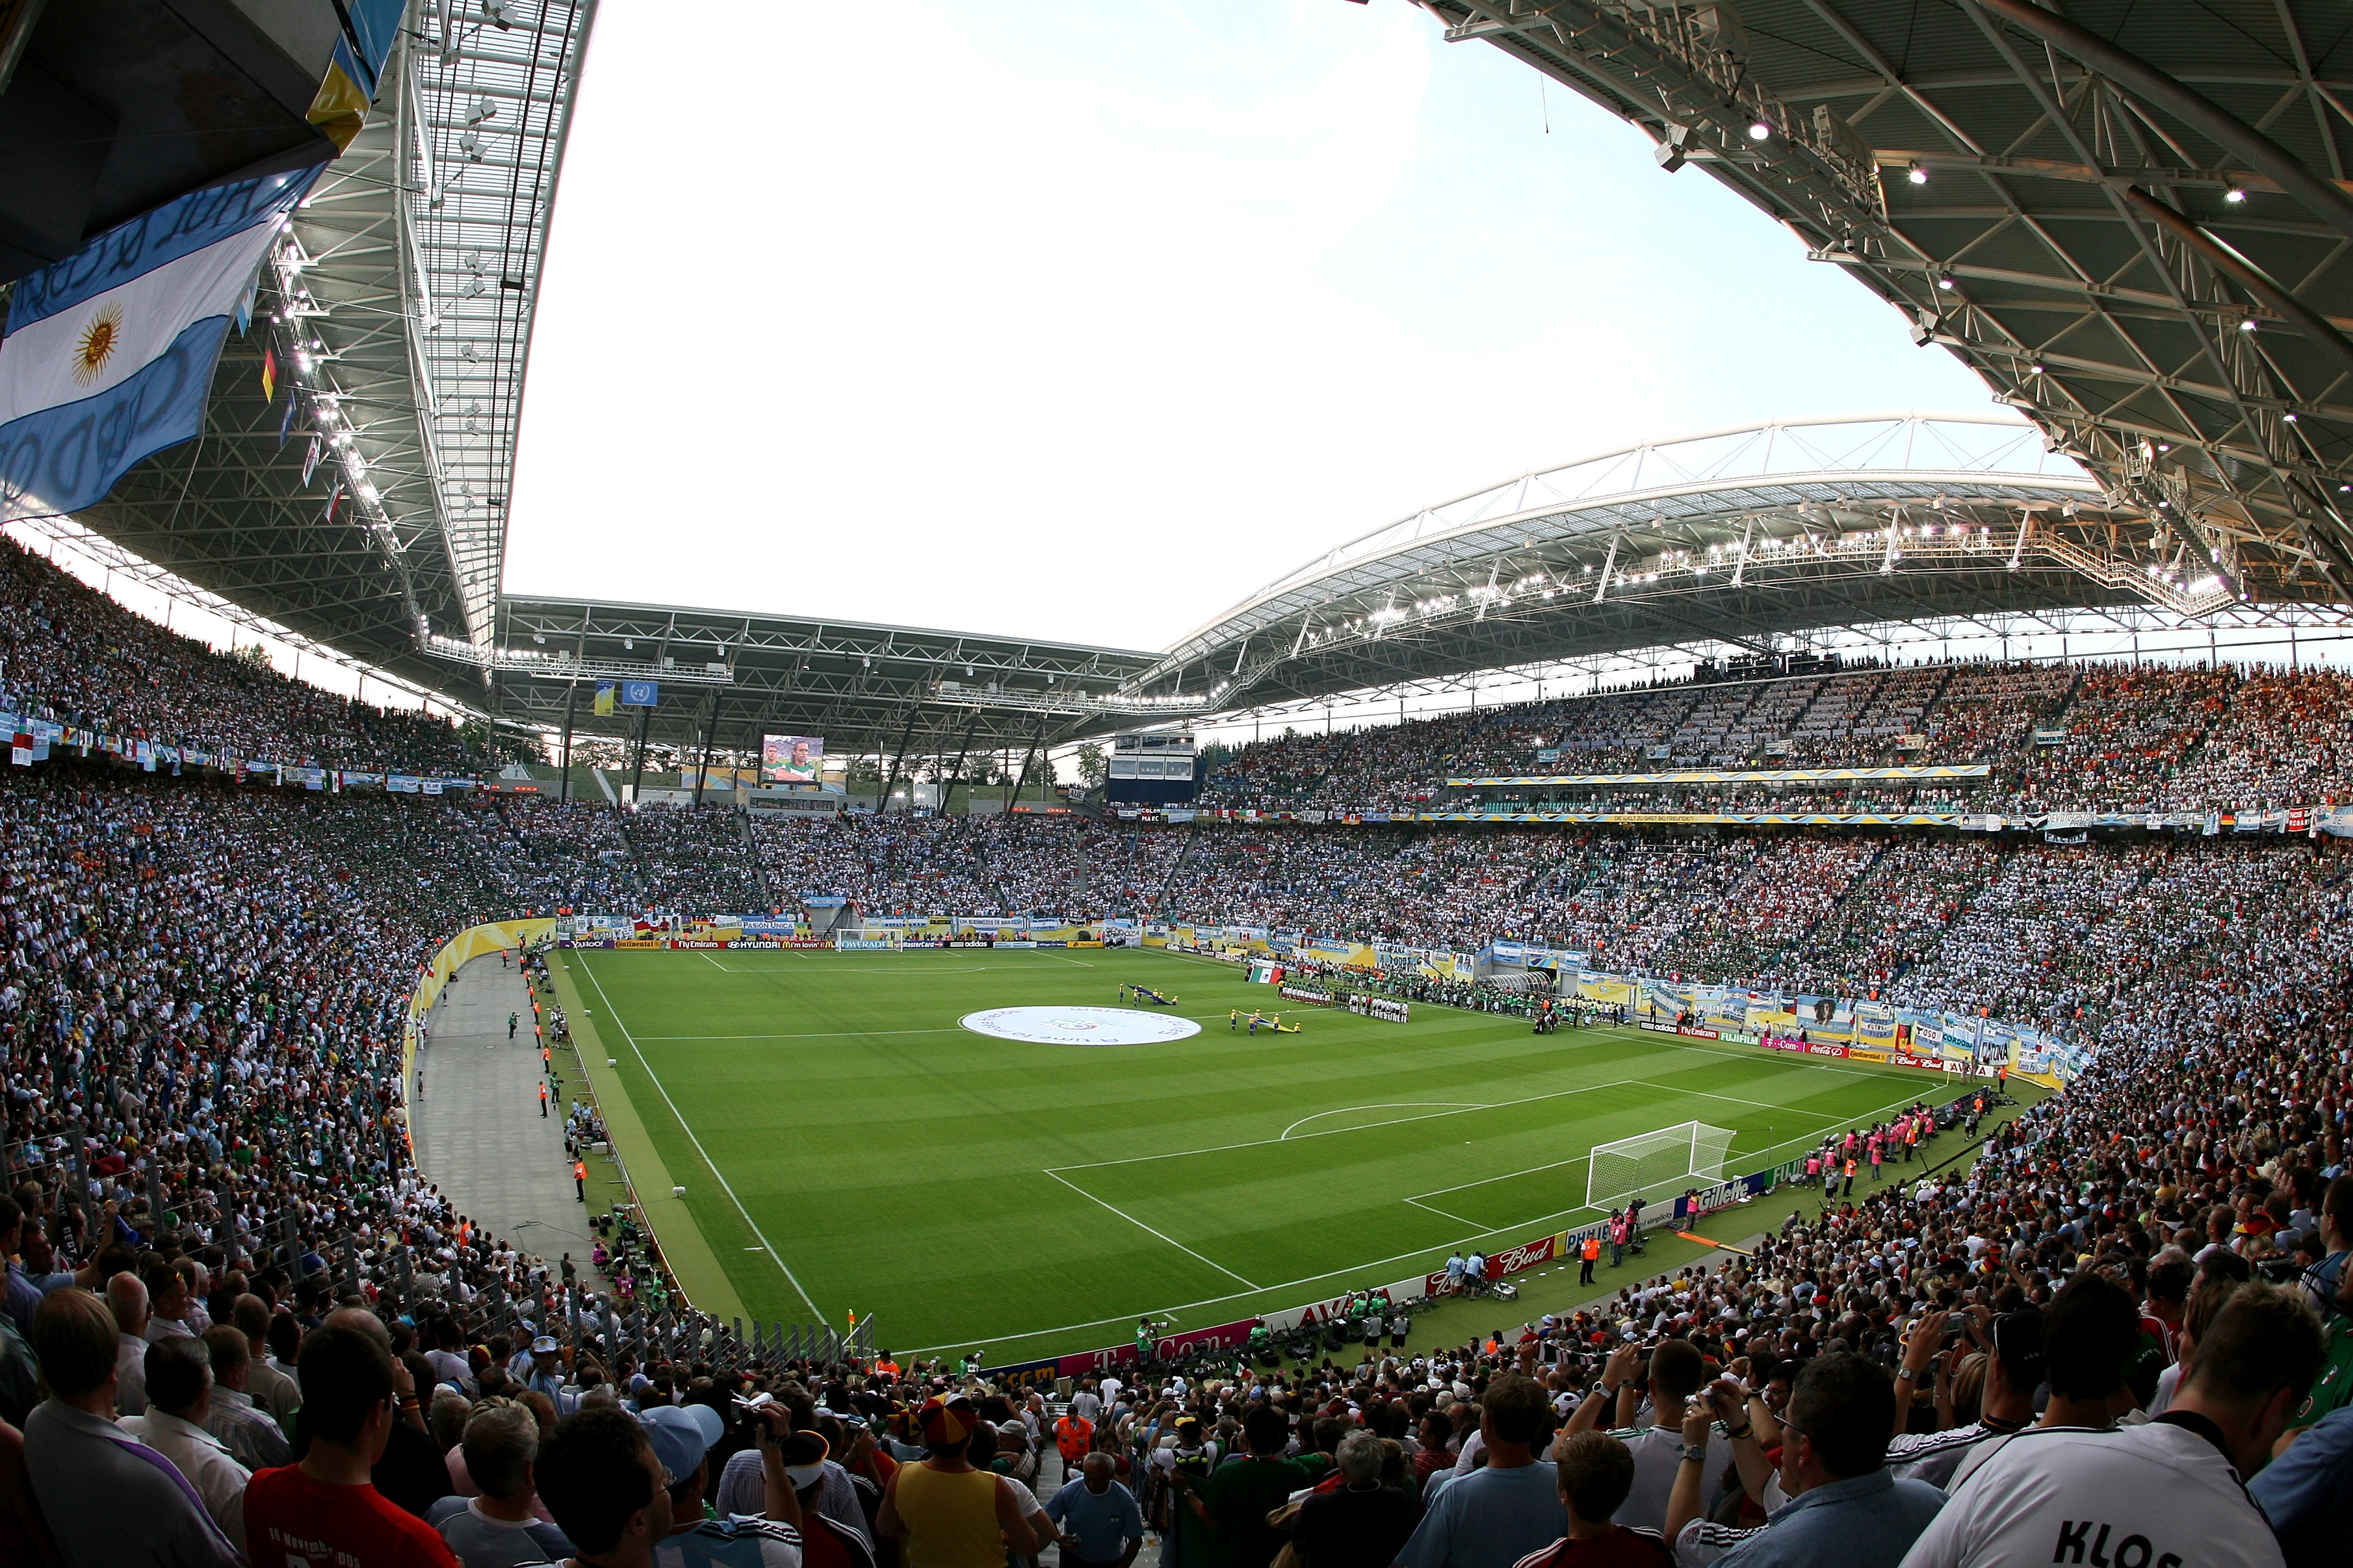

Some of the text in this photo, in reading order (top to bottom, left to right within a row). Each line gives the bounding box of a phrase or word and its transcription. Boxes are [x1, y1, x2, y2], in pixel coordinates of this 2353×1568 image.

[1069, 790, 1084, 800] AUE
[678, 940, 690, 949] Fly
[1654, 1023, 1677, 1033] adidas
[1681, 1026, 1717, 1038] Fly Emirates
[1720, 1031, 1759, 1046] FUJIFILM
[1923, 1029, 1937, 1040] OSO
[1850, 1049, 1880, 1060] Continental
[1895, 1055, 1943, 1070] Bud Bud
[1698, 1179, 1749, 1212] Gillette
[1646, 1211, 1673, 1227] simplicity
[1497, 1239, 1550, 1274] Bud
